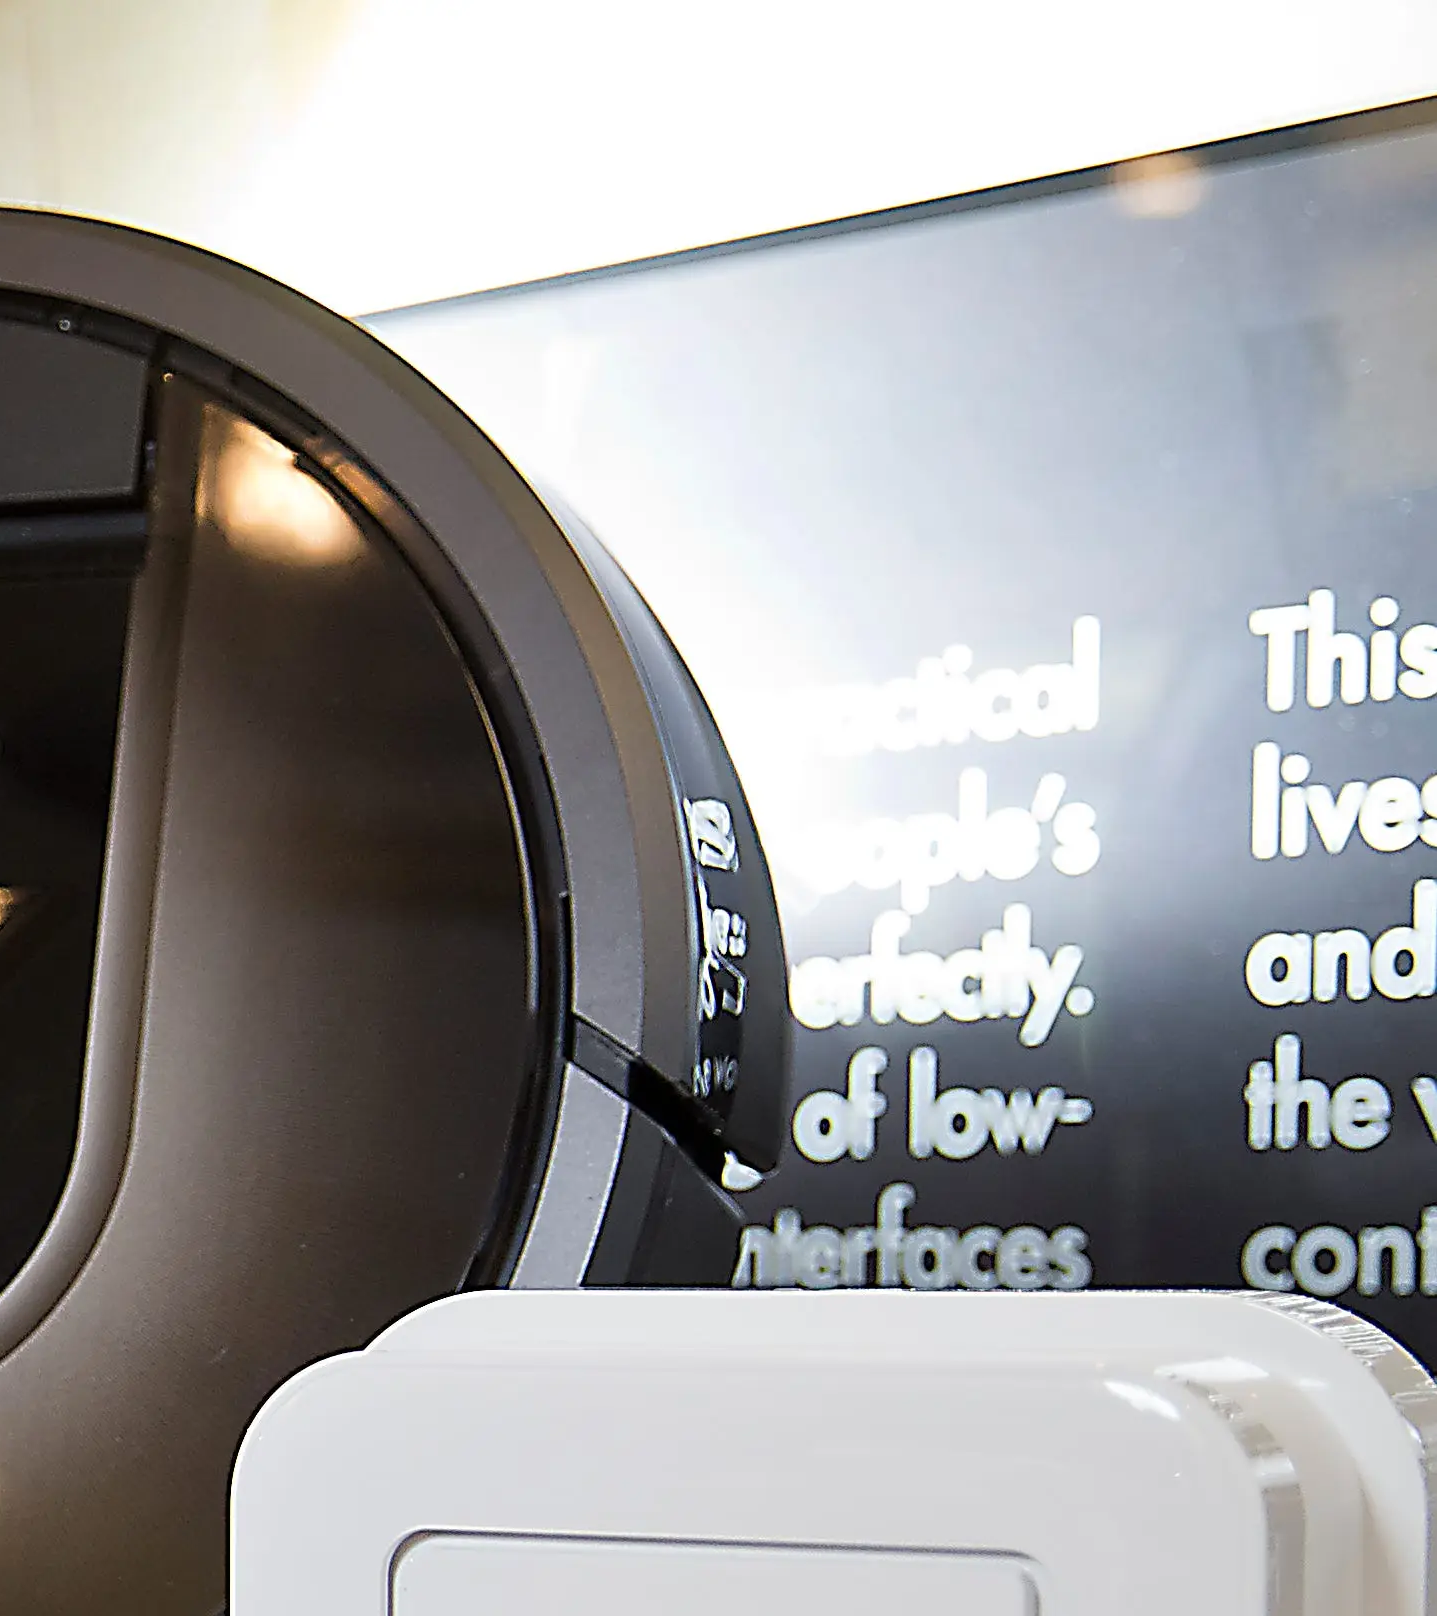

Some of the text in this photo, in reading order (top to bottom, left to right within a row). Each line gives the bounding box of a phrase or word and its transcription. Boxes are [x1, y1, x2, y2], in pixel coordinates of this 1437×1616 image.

[788, 902, 1095, 1048] erfectly.
[1245, 878, 1437, 1006] and
[792, 1045, 1095, 1163] of low-
[1244, 1033, 1392, 1151] the
[731, 1182, 1092, 1289] nterfaces
